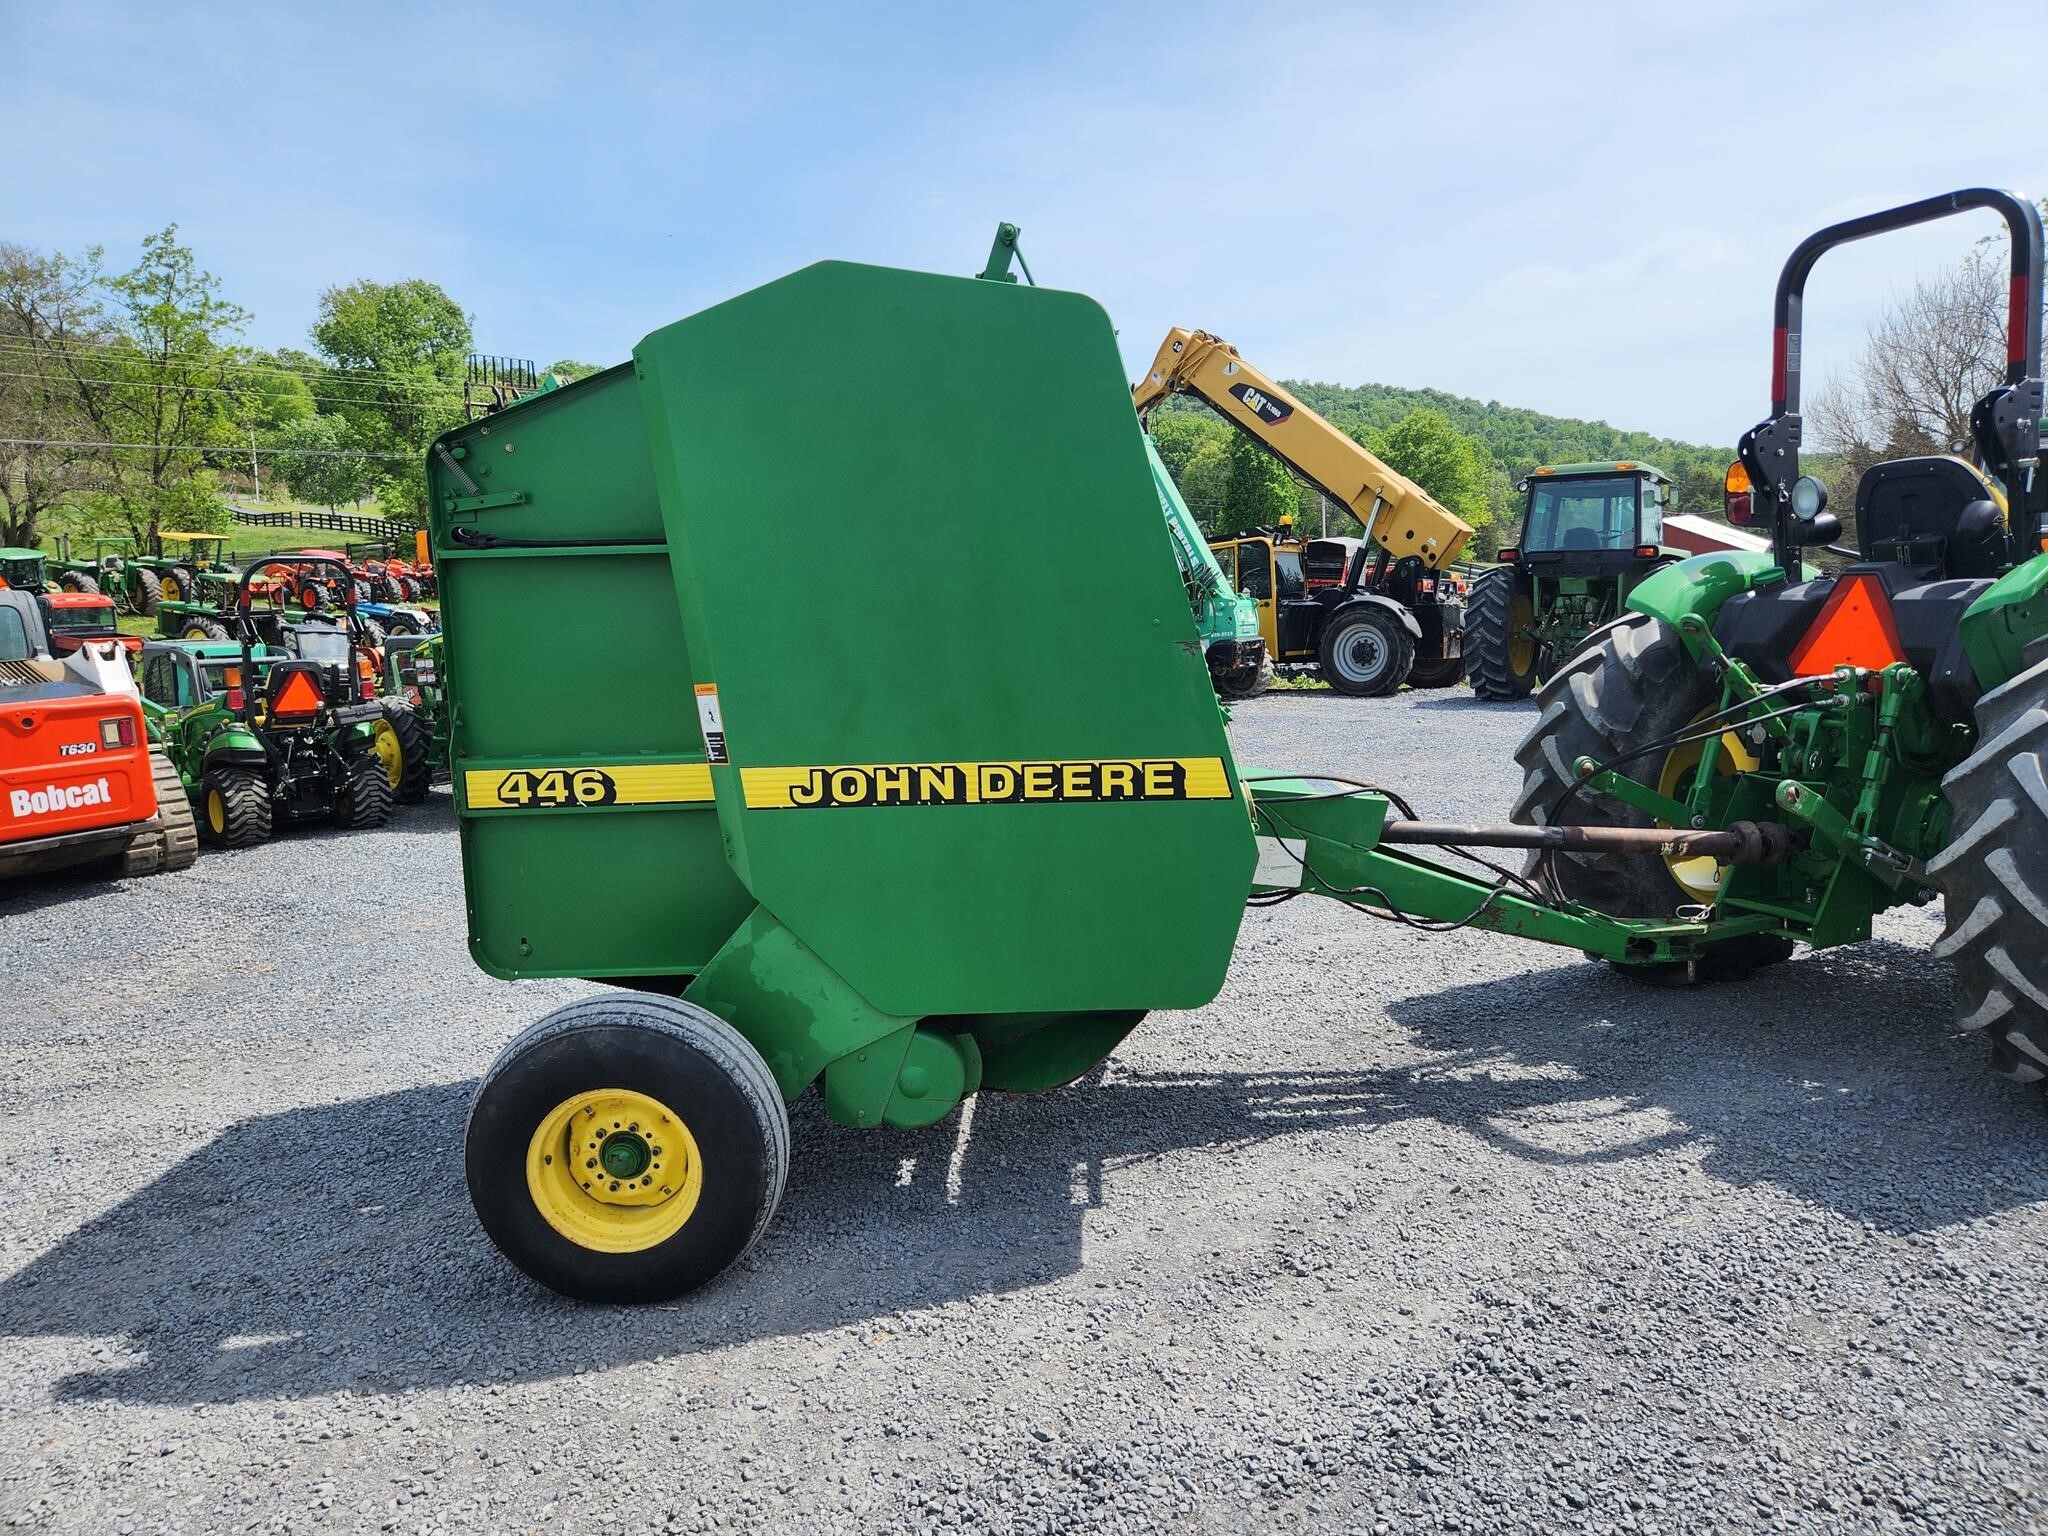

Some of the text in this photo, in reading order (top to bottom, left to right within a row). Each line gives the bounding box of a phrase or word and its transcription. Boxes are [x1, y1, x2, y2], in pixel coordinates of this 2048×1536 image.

[1242, 387, 1267, 413] CAT
[60, 742, 97, 756] T630
[9, 777, 112, 818] Bobcat
[498, 769, 612, 806] 446
[790, 762, 1182, 805] JOHN DEERE
